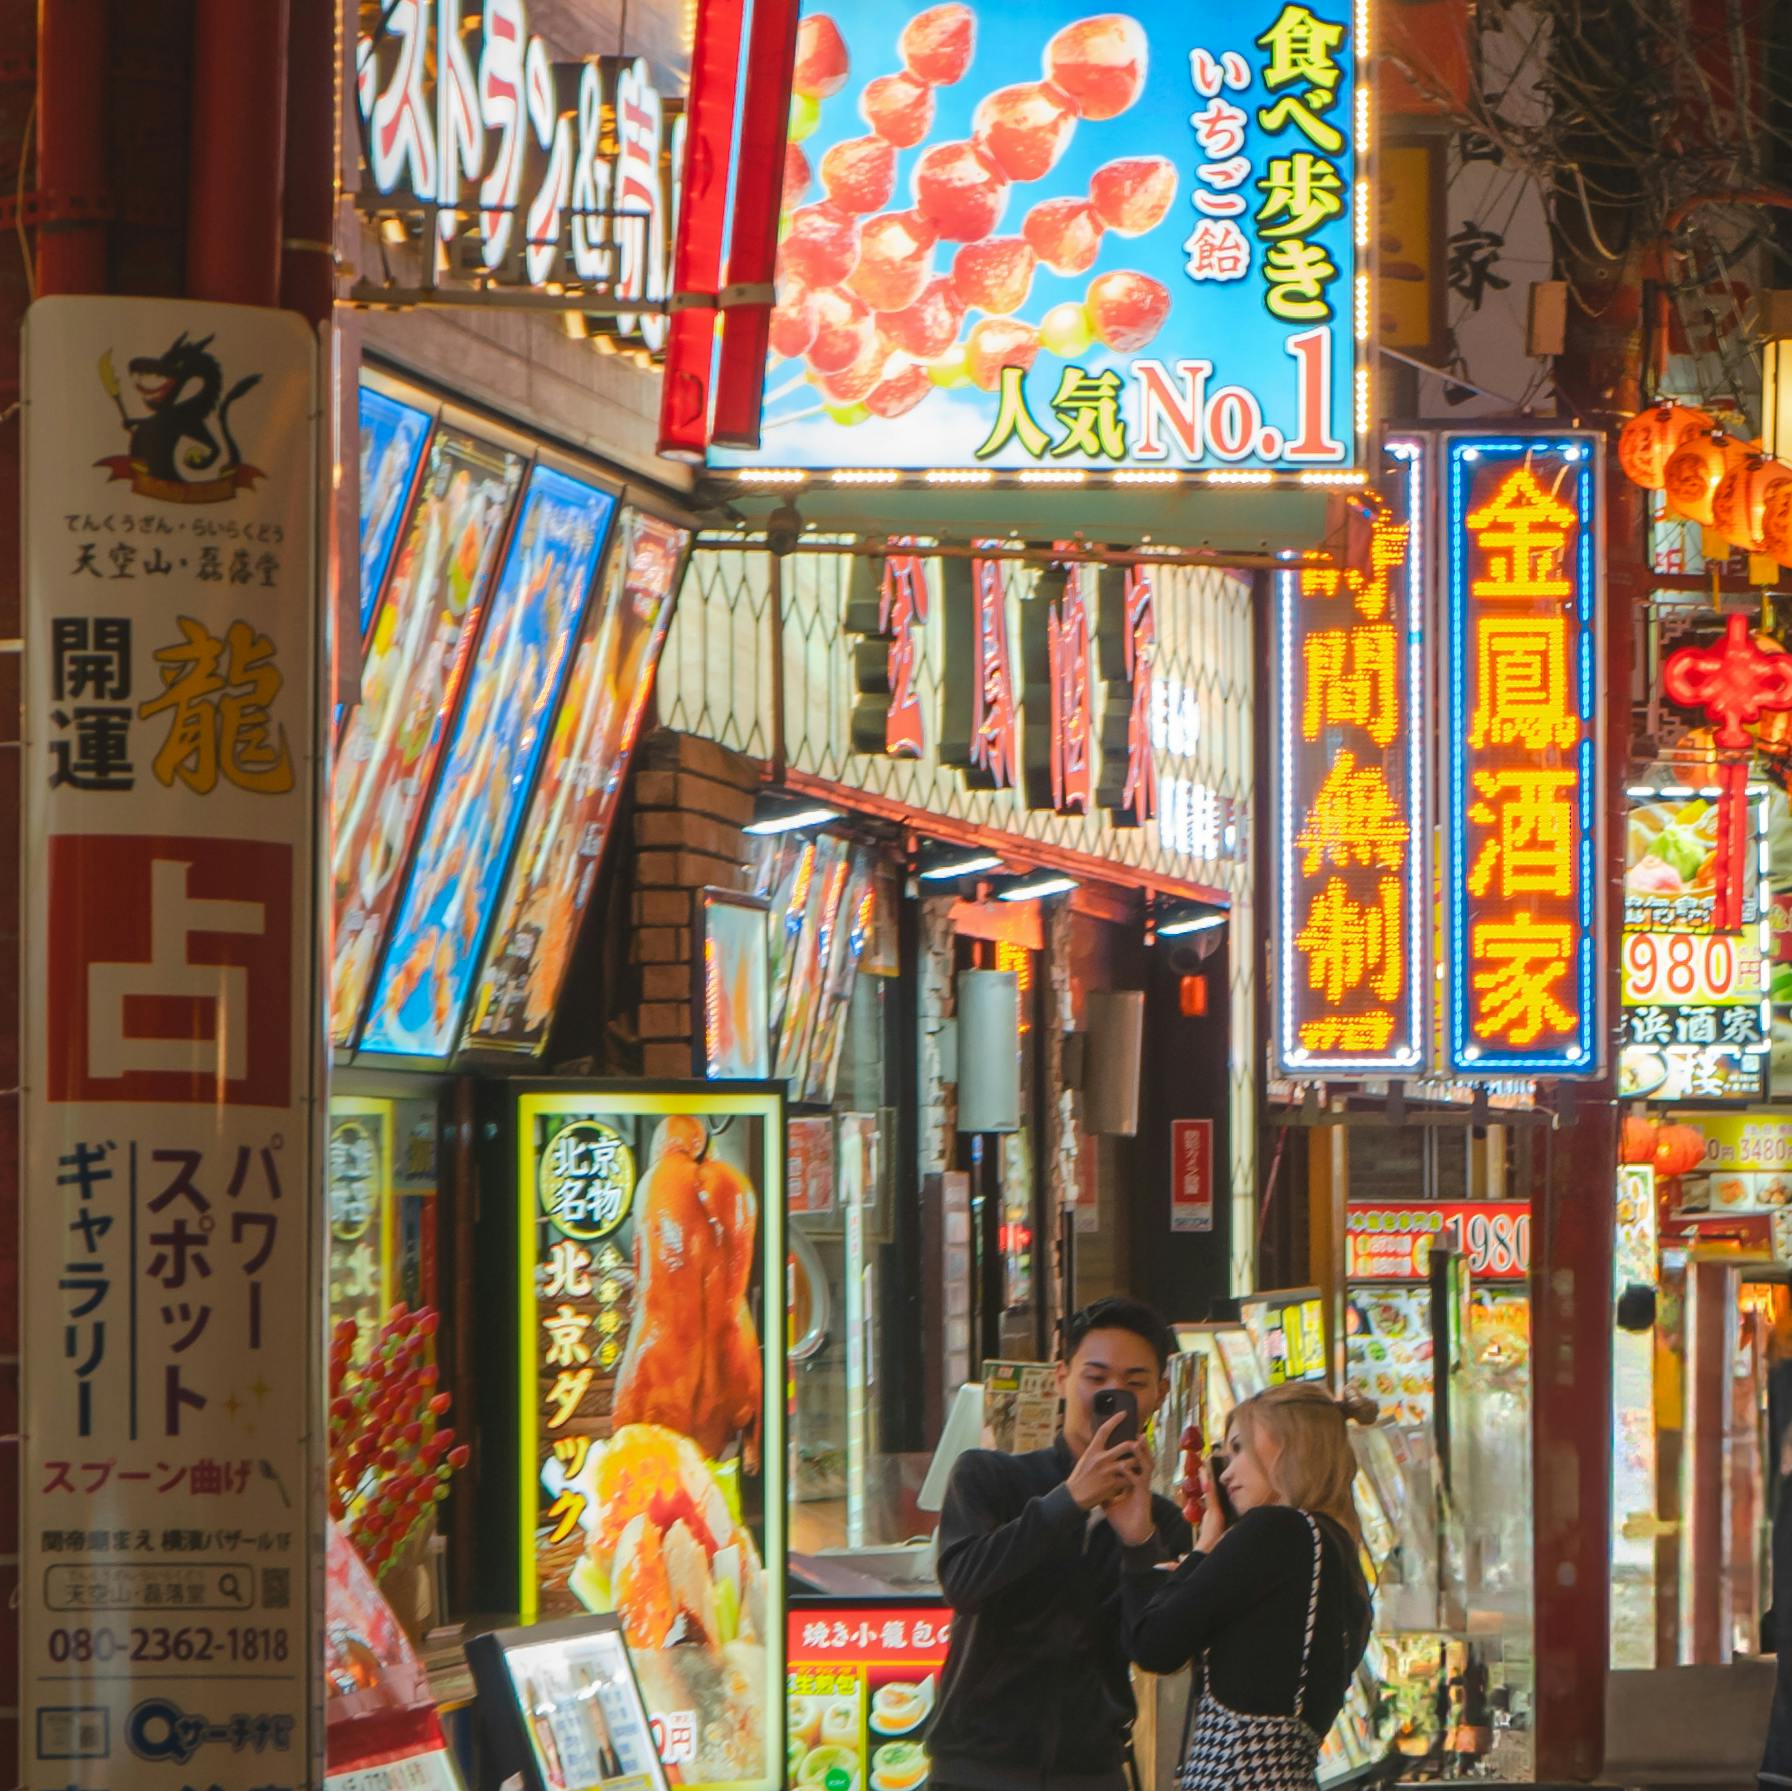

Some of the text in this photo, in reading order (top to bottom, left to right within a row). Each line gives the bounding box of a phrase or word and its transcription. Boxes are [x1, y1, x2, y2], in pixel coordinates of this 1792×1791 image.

[1184, 48, 1251, 280] いちご飴
[1256, 5, 1346, 323] 食べ歩き
[49, 615, 136, 793] 開運
[138, 614, 296, 796] 龍
[1466, 469, 1576, 1046] 金鳳酒家
[87, 858, 266, 1081] 占
[1614, 1004, 1762, 1046] 浜酒家
[226, 1133, 285, 1350] パワー
[549, 1177, 623, 1224] 名物
[551, 1134, 624, 1179] 北京
[56, 1140, 117, 1437] ギャラリー
[146, 1149, 215, 1437] スポット
[543, 1240, 595, 1545] 北京ダック
[41, 1457, 252, 1496] スプーン曲げ
[48, 1626, 290, 1663] 080-2362-1818
